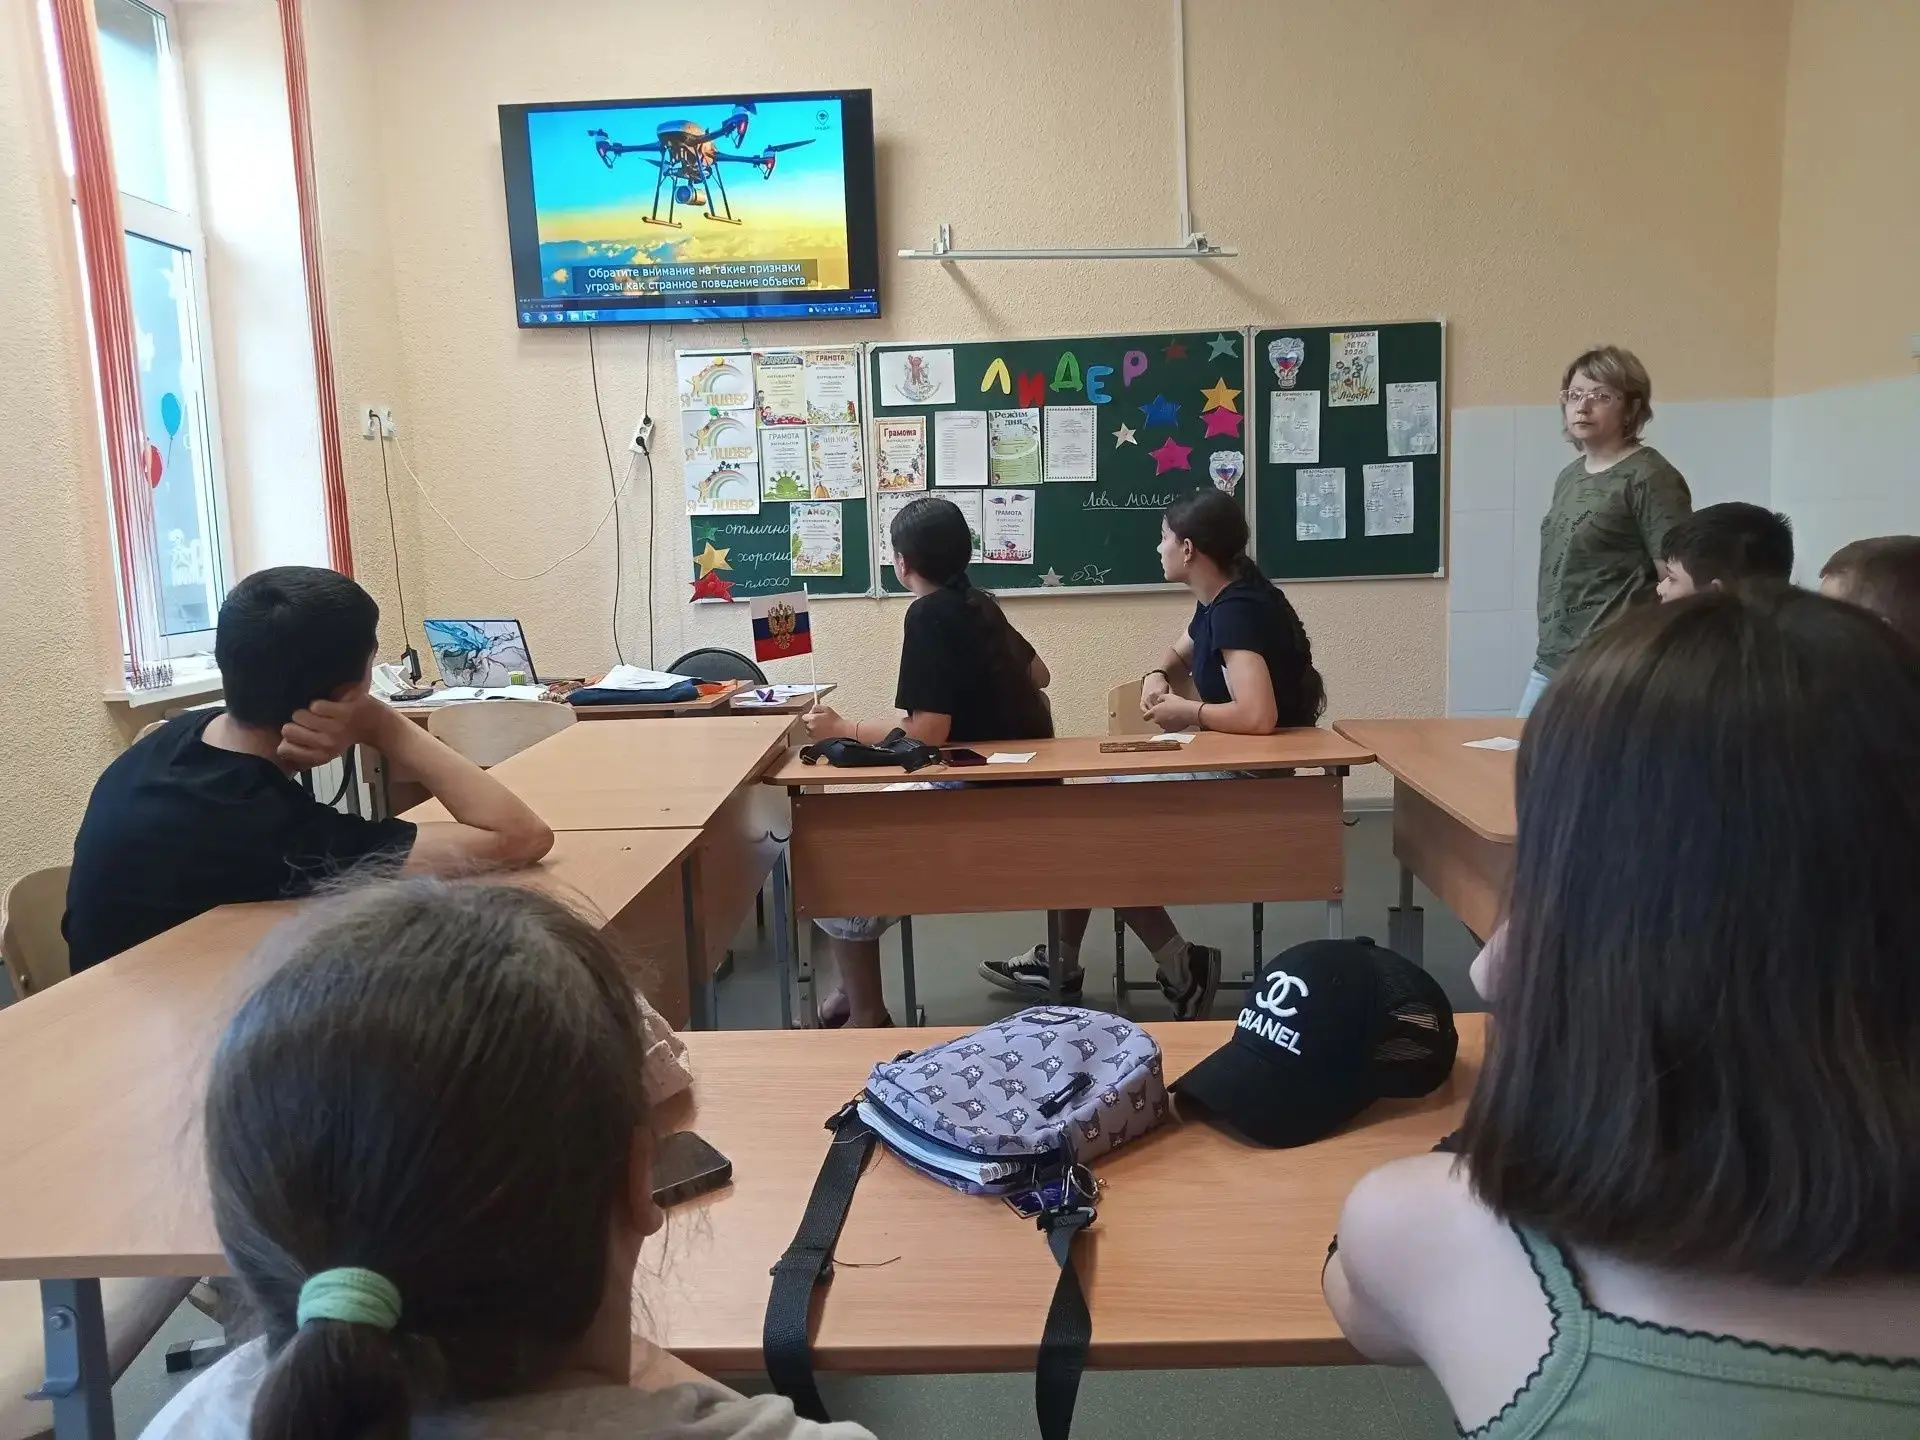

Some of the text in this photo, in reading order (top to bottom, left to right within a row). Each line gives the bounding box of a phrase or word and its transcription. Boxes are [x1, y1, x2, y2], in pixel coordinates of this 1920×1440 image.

[588, 263, 801, 279] Обратите внимание на такие признаки
[585, 276, 806, 294] угрозы как странное поведение объекта
[816, 354, 845, 362] ГРАМОТА
[980, 350, 1148, 408] ЛИДЕР
[994, 411, 1028, 419] Режим
[884, 428, 917, 438] Грамота
[1237, 1007, 1302, 1056] CHANEL
